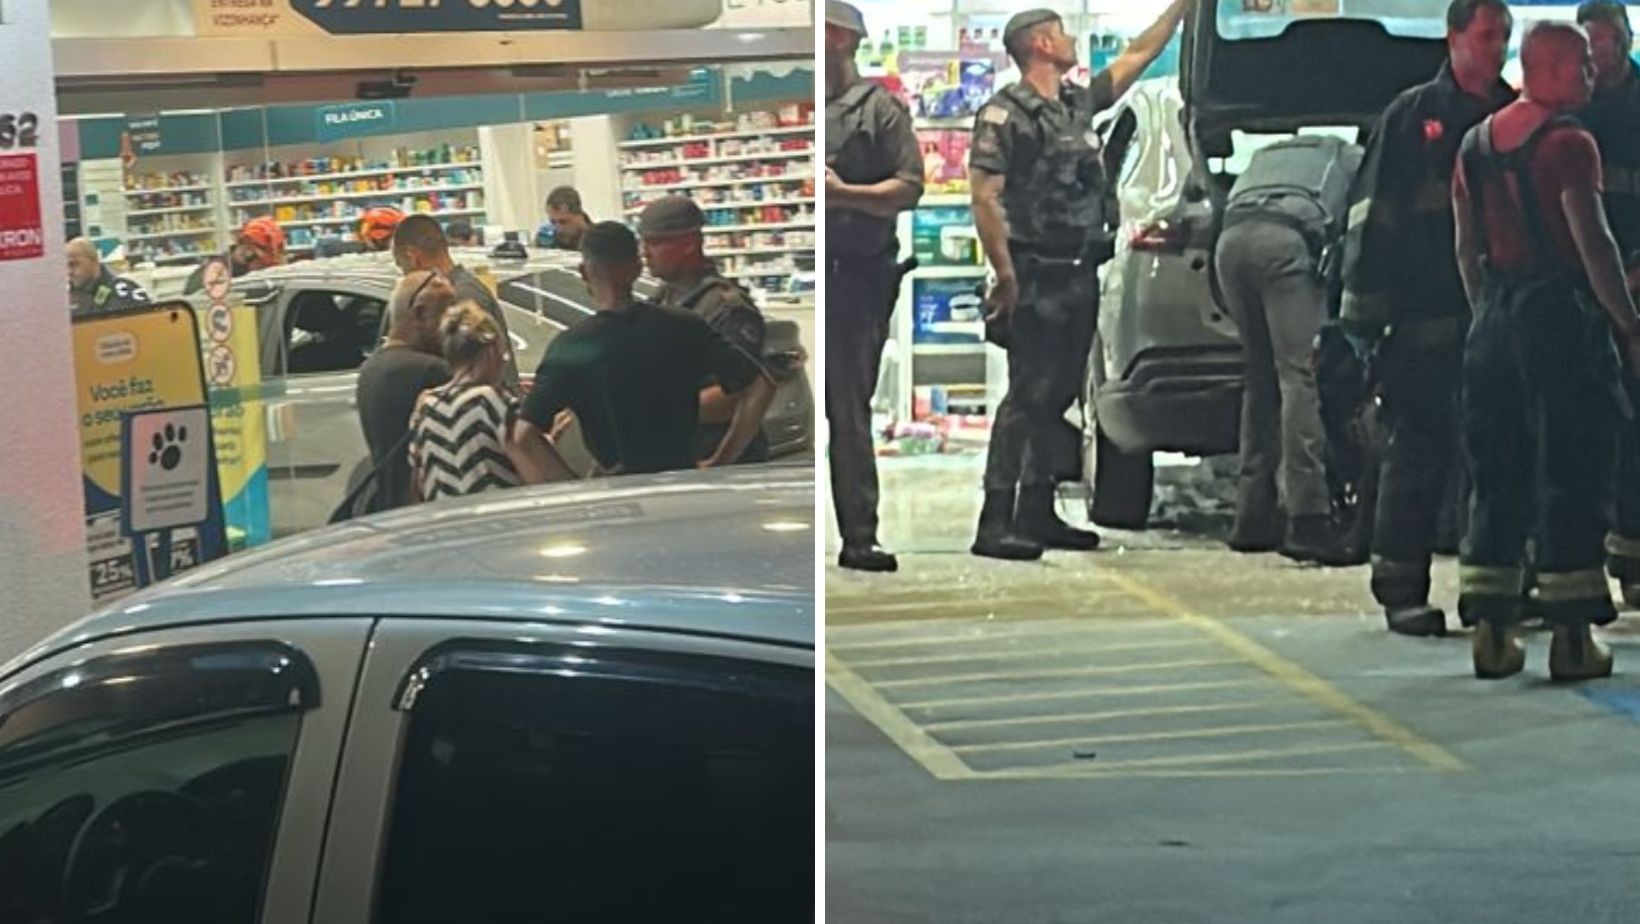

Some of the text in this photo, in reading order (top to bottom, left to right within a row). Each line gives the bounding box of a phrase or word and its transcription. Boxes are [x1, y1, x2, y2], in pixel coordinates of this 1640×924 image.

[325, 112, 349, 125] FILA
[90, 376, 152, 402] Você faz
